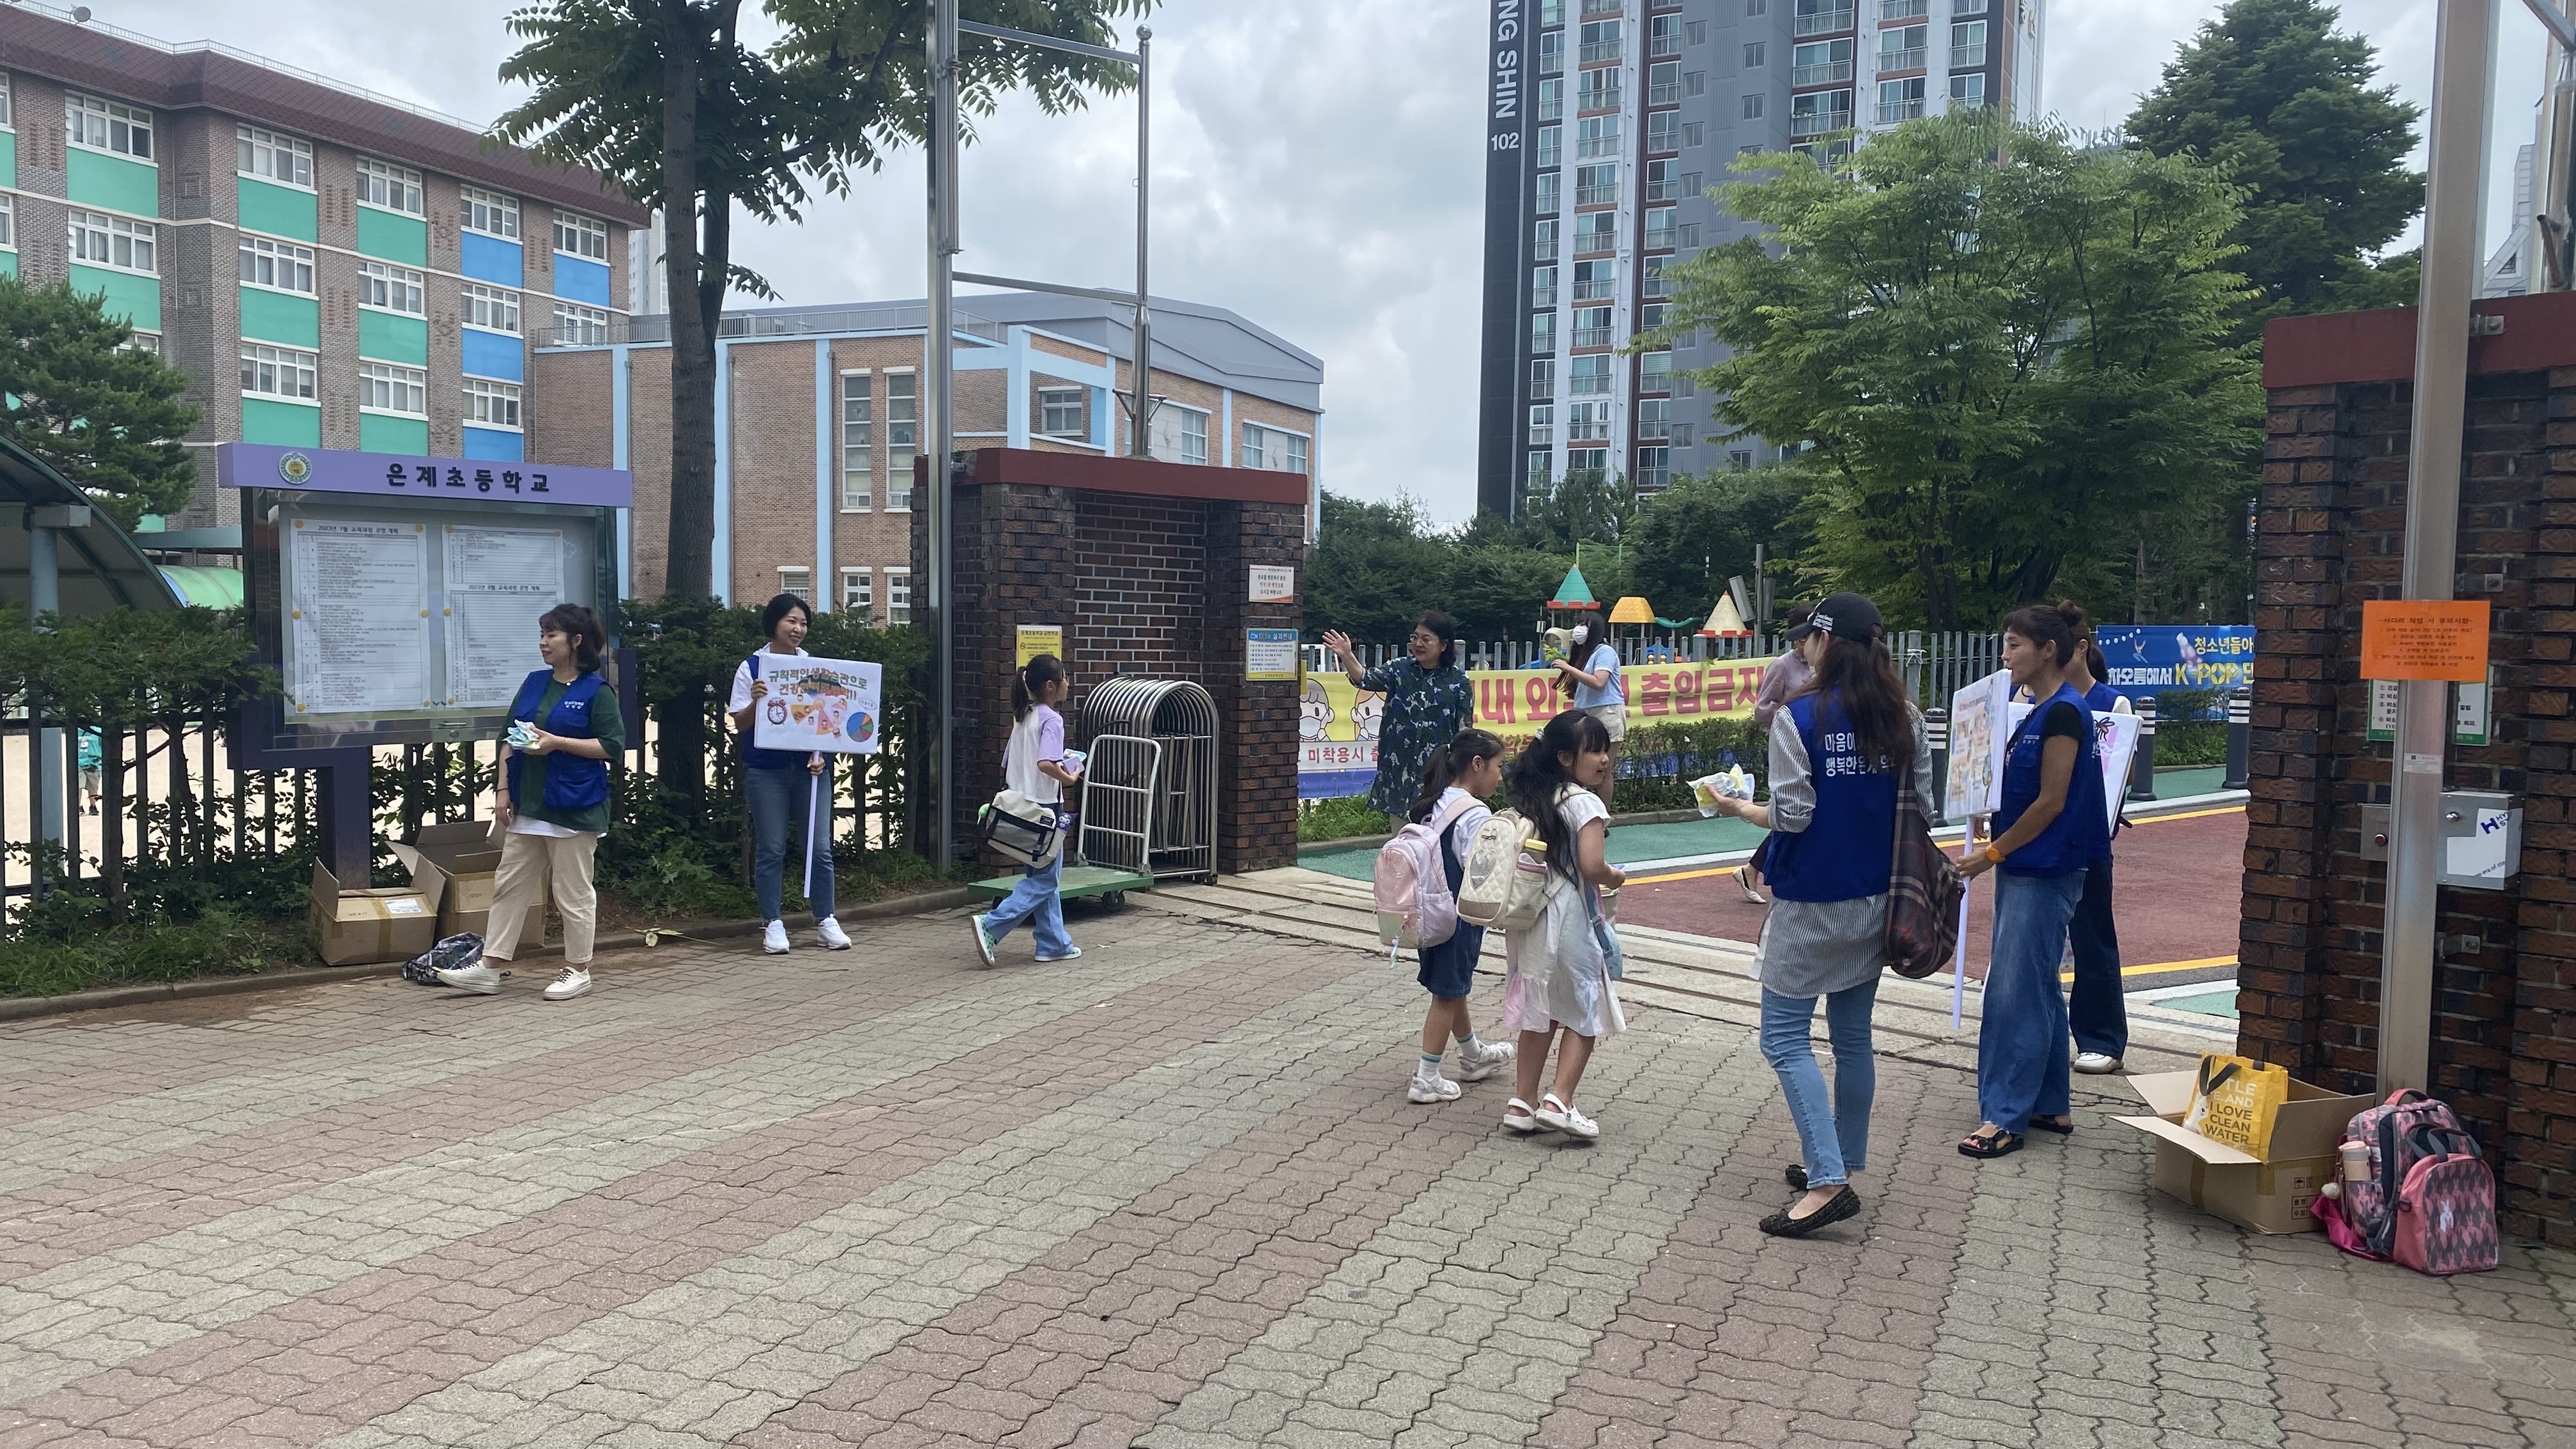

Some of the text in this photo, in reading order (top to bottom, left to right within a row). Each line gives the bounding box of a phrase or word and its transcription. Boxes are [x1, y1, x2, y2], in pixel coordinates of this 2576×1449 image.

[1496, 49, 1517, 119] SHIN
[1491, 132, 1519, 151] 102
[386, 463, 550, 494] 은계초등학교
[2107, 667, 2172, 685] 차오름에서
[1308, 746, 1364, 763] 미착용시
[2225, 1093, 2255, 1108] AND
[2210, 1101, 2253, 1121] I LOVE
[2210, 1114, 2251, 1133] CLEAN
[2205, 1123, 2250, 1145] WATER
